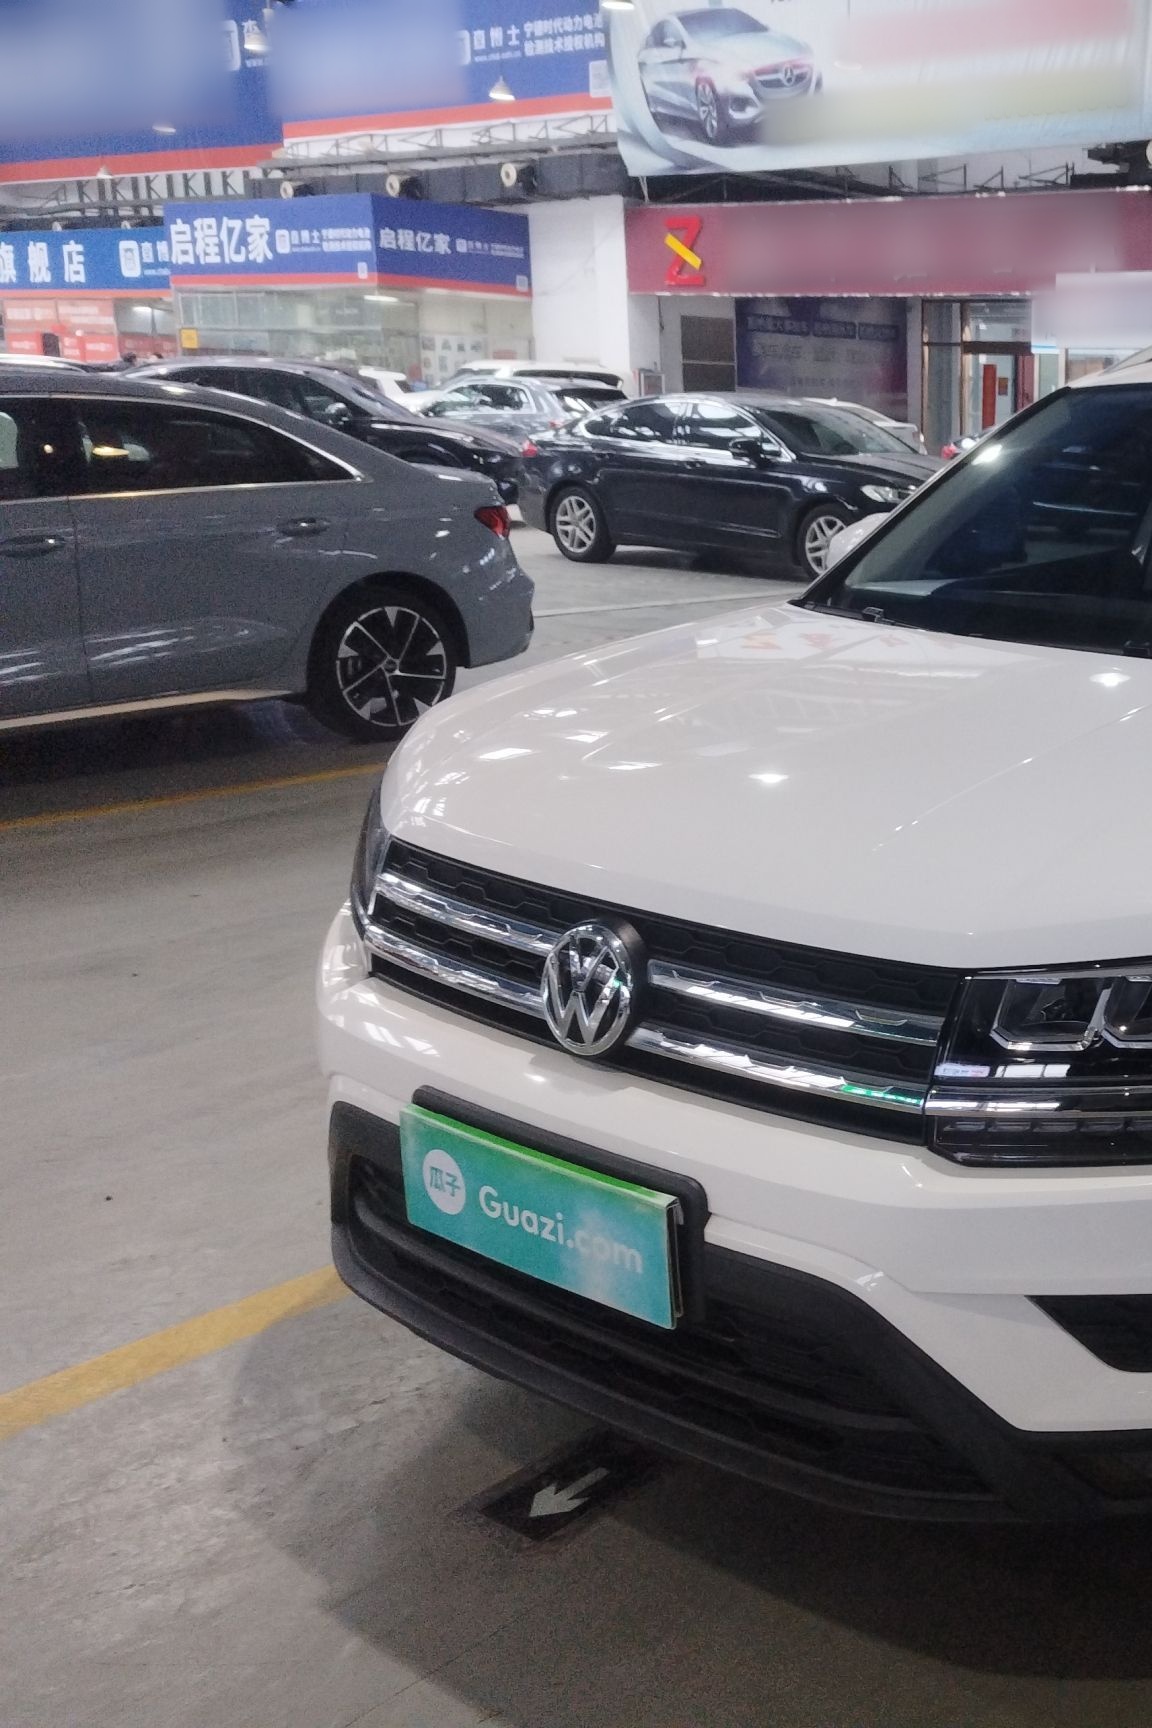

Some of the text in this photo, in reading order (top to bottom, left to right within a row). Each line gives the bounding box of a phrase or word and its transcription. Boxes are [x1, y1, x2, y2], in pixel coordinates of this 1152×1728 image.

[170, 214, 273, 264] 启程亿家
[379, 227, 451, 254] 启程亿家
[429, 1166, 461, 1198] 瓜子
[479, 1185, 644, 1275] Guazi.com
